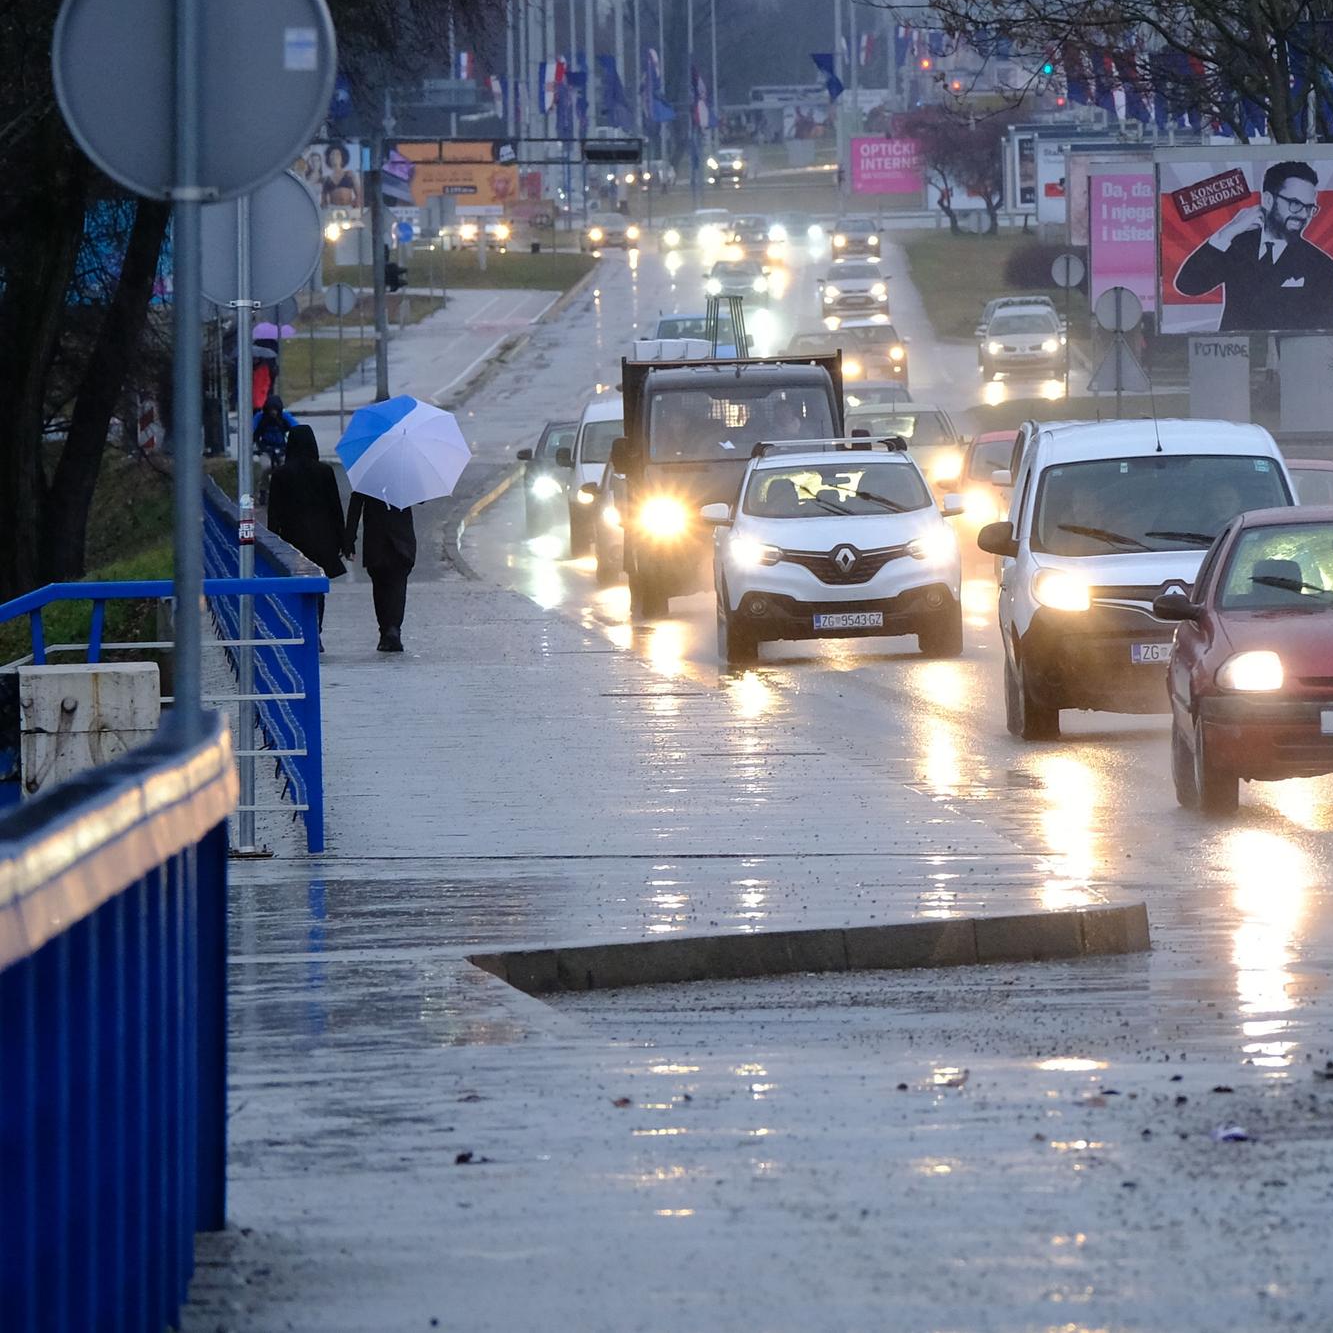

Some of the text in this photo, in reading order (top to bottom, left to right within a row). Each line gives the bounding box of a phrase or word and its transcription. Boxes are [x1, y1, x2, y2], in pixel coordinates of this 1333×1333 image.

[859, 140, 916, 157] OPTIČKI
[860, 156, 919, 171] INTERNE
[1190, 174, 1241, 201] KONCERT
[1182, 185, 1246, 215] RASPRODAN
[1111, 225, 1155, 242] ušted
[822, 615, 835, 627] ZG
[1143, 645, 1160, 660] ZG
